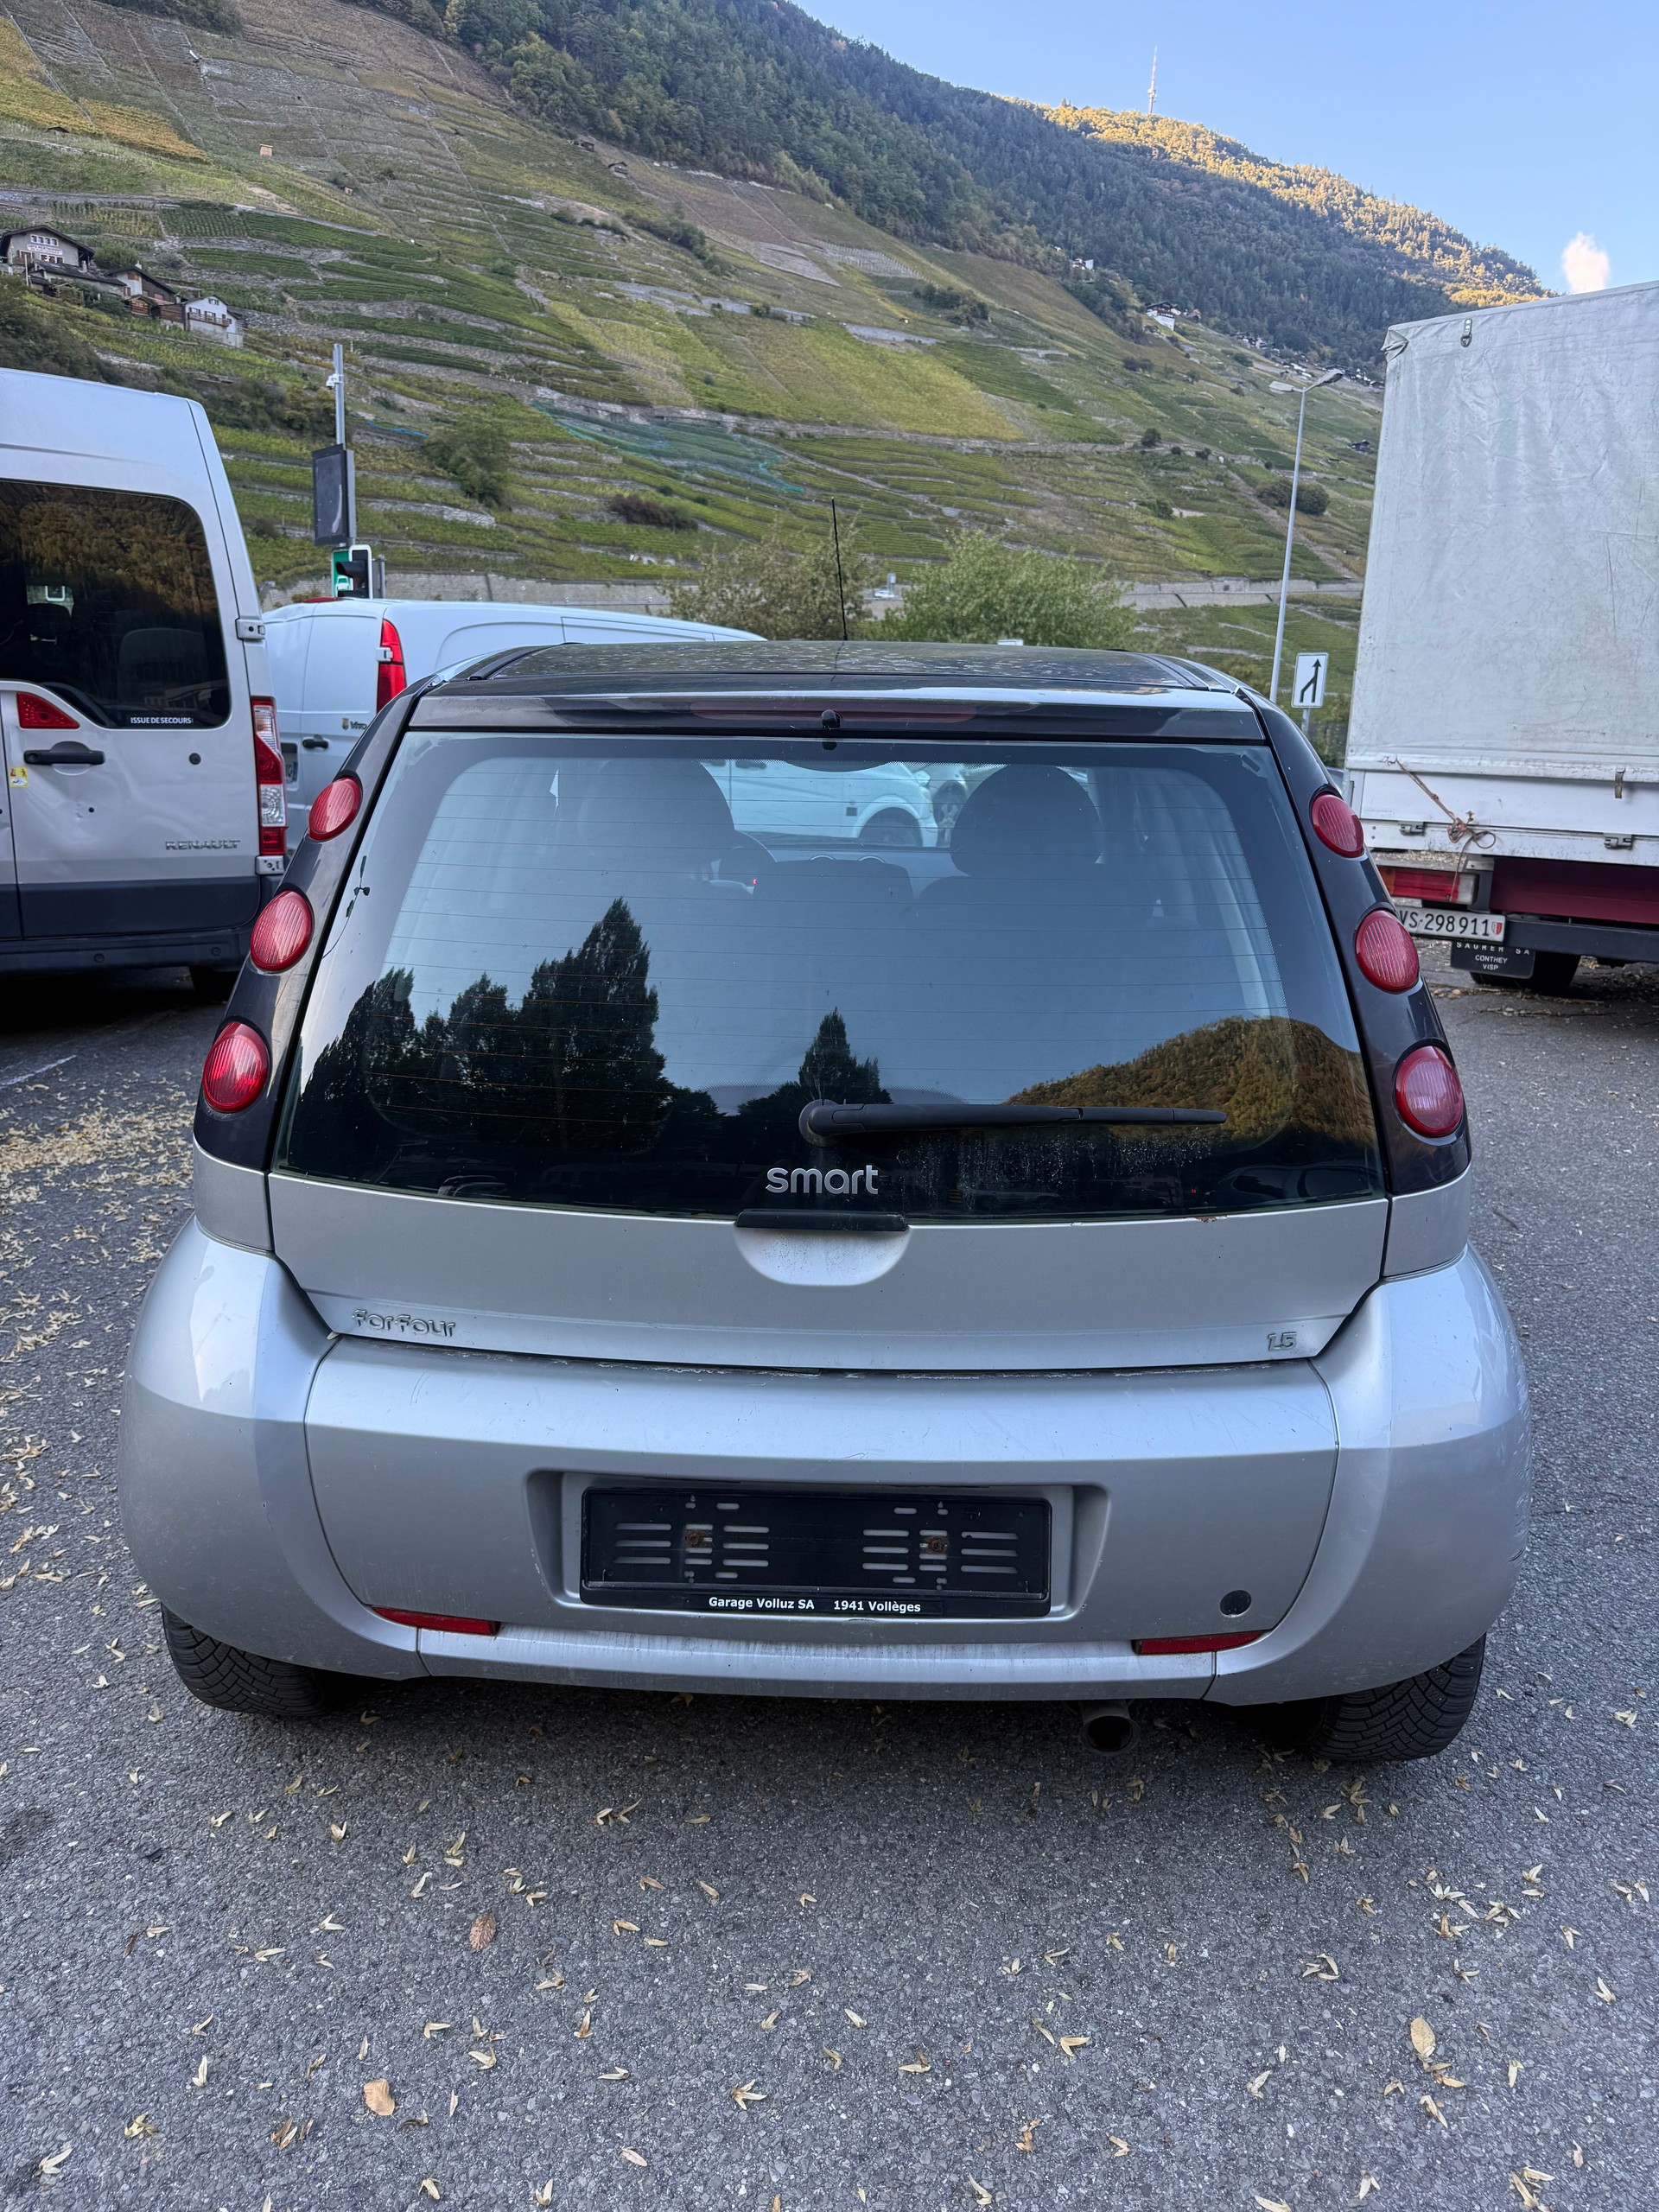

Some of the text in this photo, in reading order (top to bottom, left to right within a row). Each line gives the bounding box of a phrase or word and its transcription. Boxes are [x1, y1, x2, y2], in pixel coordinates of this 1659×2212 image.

[165, 840, 240, 850] RENAULT
[1475, 954, 1508, 964] CONTHEY
[765, 1165, 879, 1195] smart
[352, 1309, 455, 1338] forfour
[709, 1597, 921, 1614] Garage Volluz SA 1941 Vollèges
